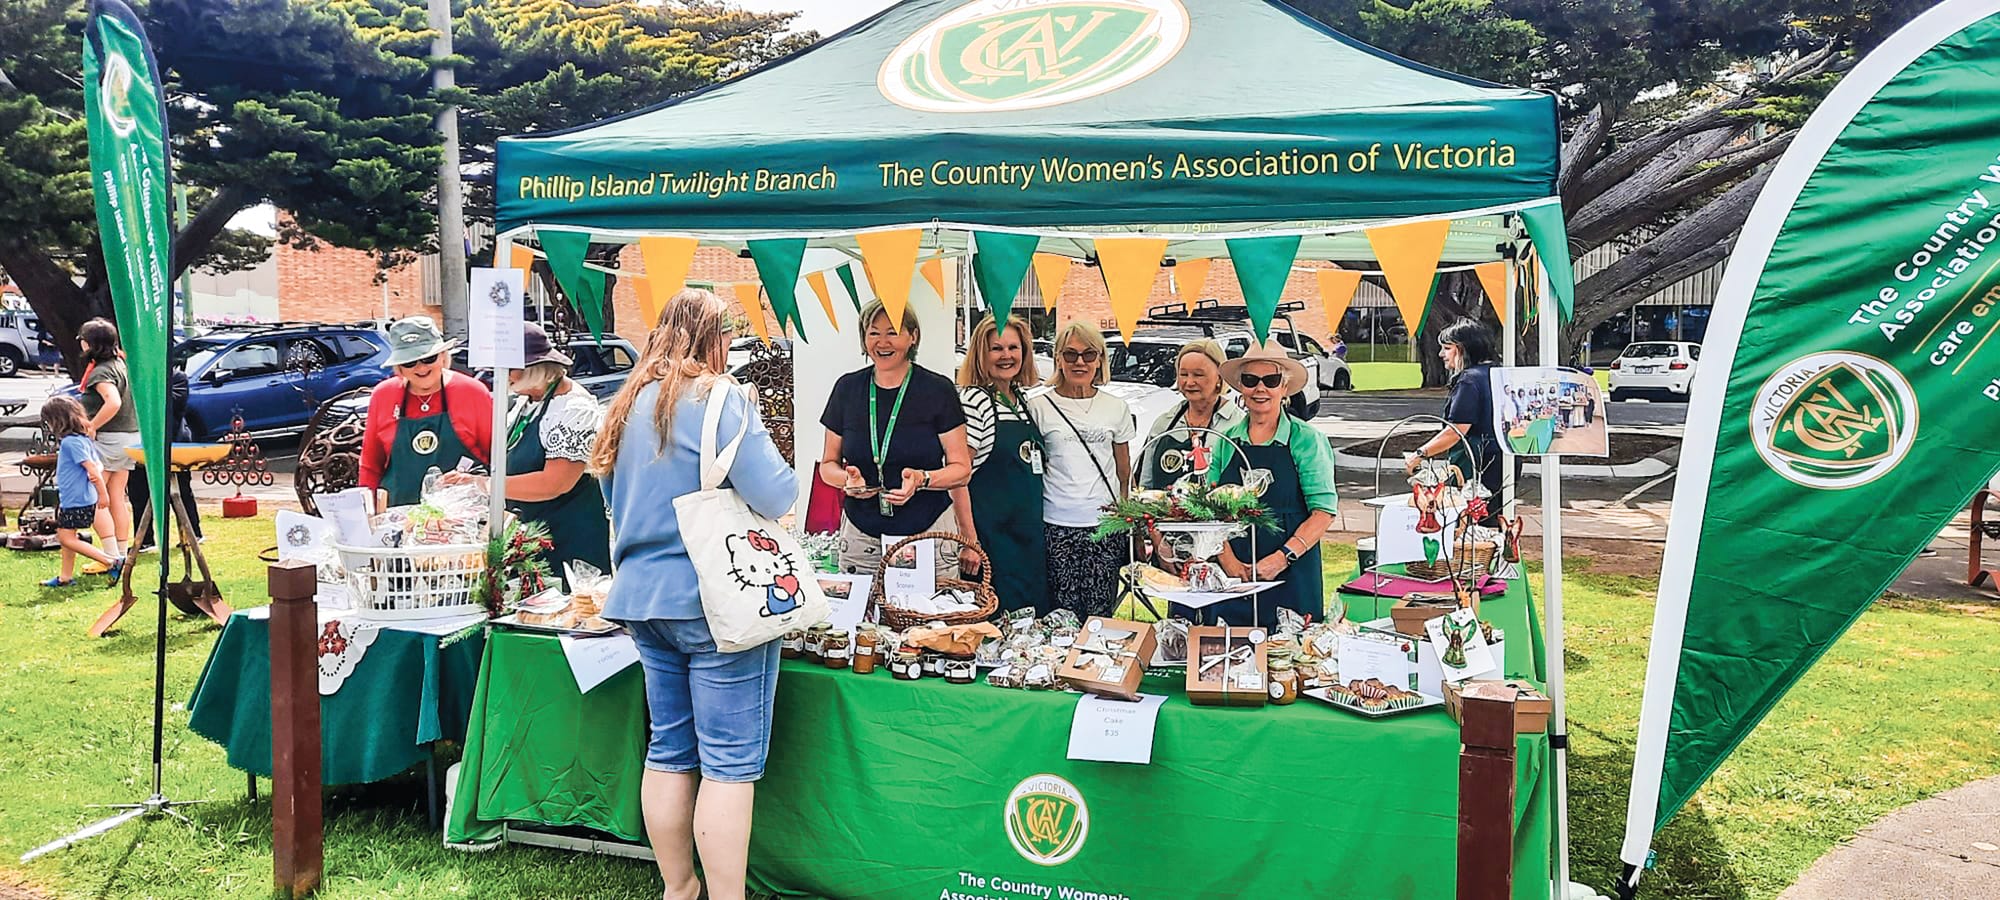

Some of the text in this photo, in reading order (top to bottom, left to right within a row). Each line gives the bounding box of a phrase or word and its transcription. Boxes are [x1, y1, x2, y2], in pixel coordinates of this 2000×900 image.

[519, 165, 836, 202] Phillip Island Twilight Branch
[879, 139, 1516, 191] The Country Women's Association of Victoria
[103, 170, 127, 244] Phillip Island
[1848, 189, 1990, 325] The Country
[1929, 320, 1975, 366] care
[1763, 369, 1815, 421] VICTORIA
[1028, 782, 1067, 796] VICTORIA
[958, 872, 986, 888] The
[991, 877, 1052, 900] Country
